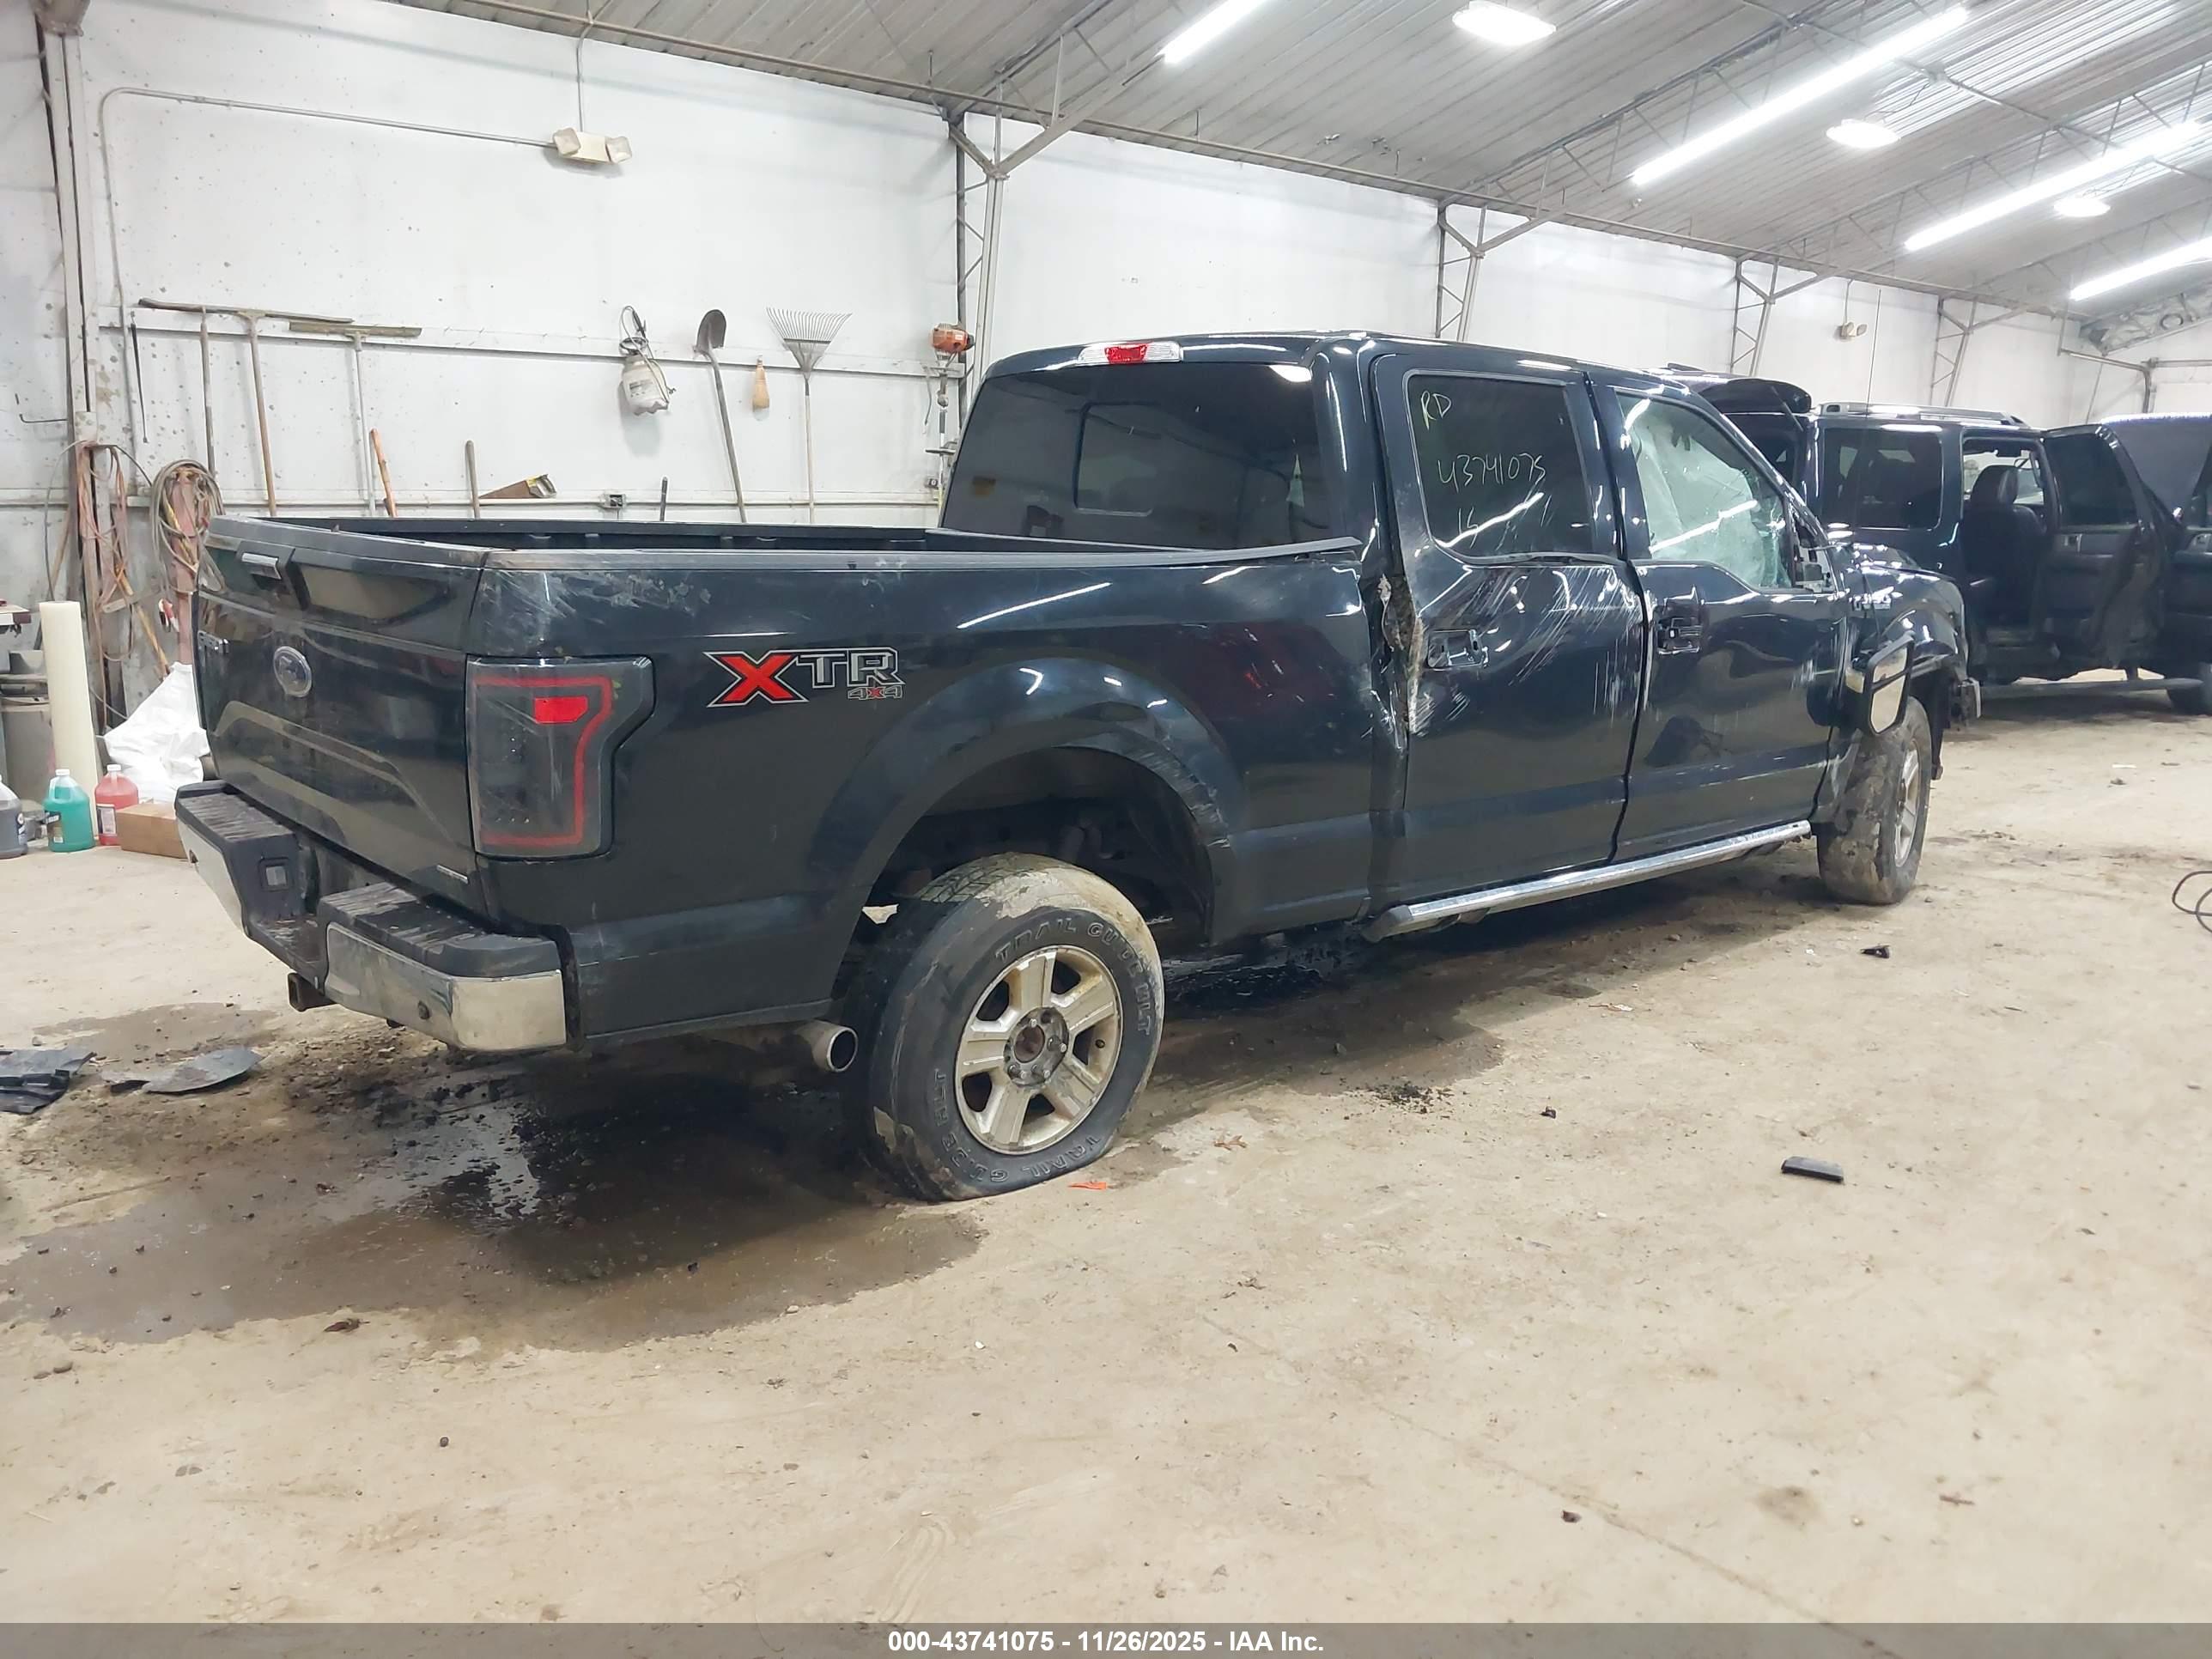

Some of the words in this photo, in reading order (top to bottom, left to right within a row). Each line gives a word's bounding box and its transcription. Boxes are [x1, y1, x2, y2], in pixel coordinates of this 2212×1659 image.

[1420, 390, 1452, 430] RD
[1437, 453, 1547, 493] 43741075
[702, 647, 905, 708] XTR
